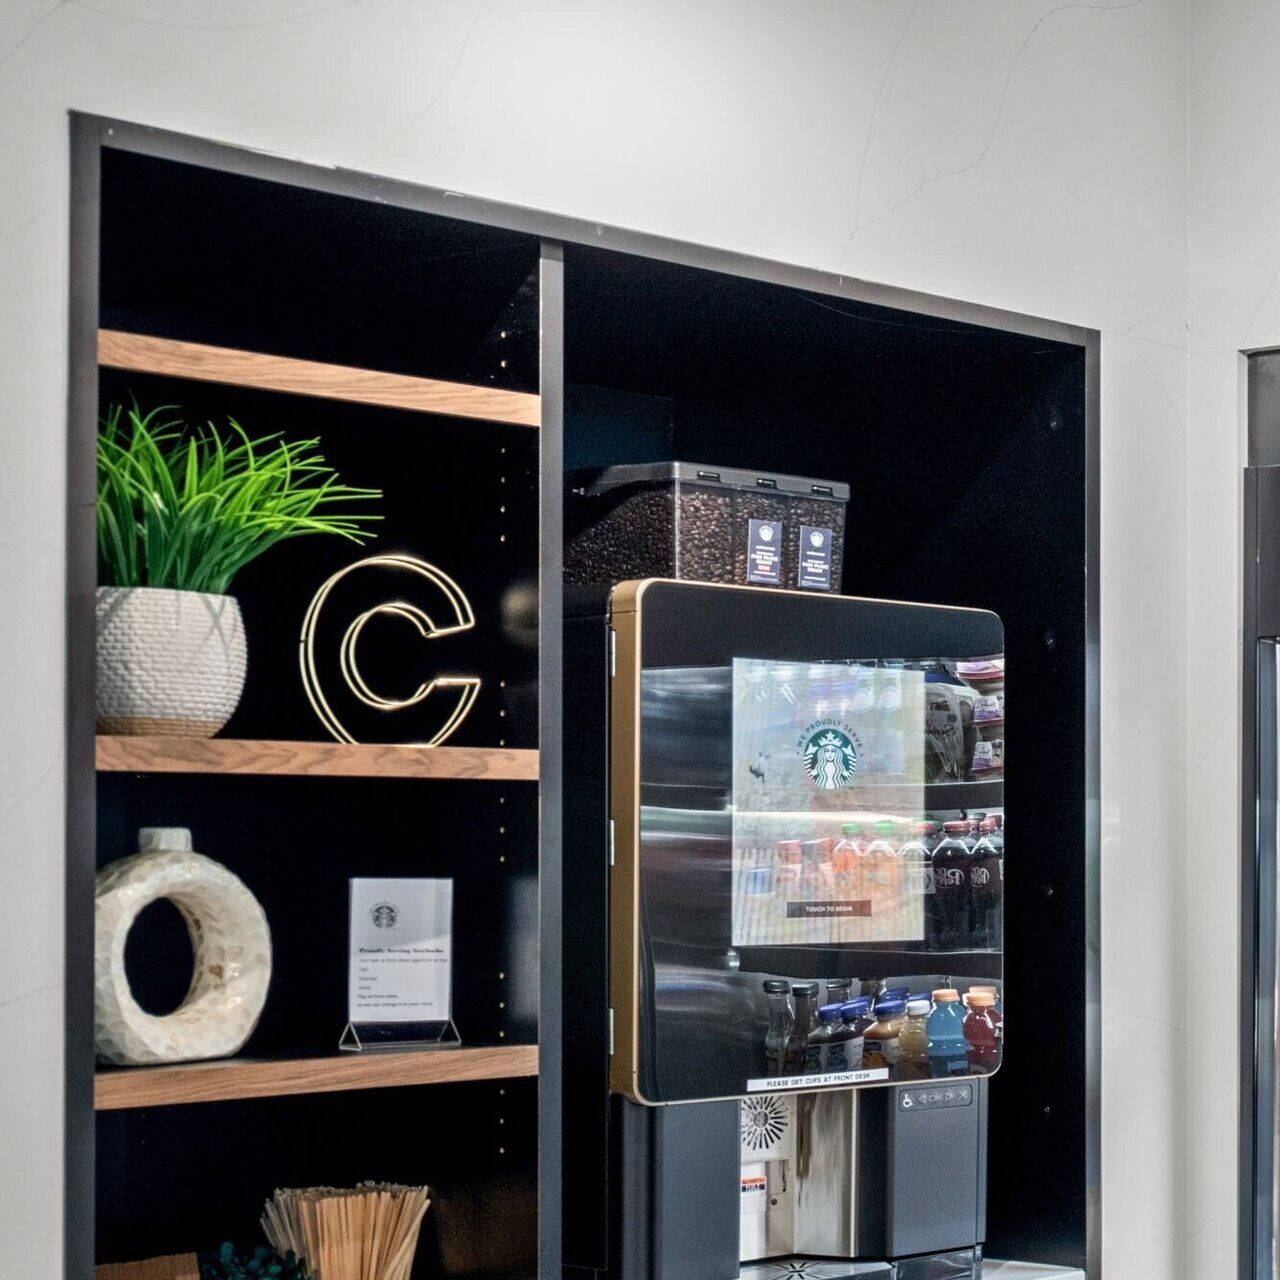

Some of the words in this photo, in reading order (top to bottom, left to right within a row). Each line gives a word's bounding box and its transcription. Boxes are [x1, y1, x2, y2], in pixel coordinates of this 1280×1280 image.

[806, 719, 841, 733] PROUDLY
[845, 724, 862, 747] SERVE
[767, 1079, 792, 1087] PLEASE
[805, 1076, 822, 1084] CUPS
